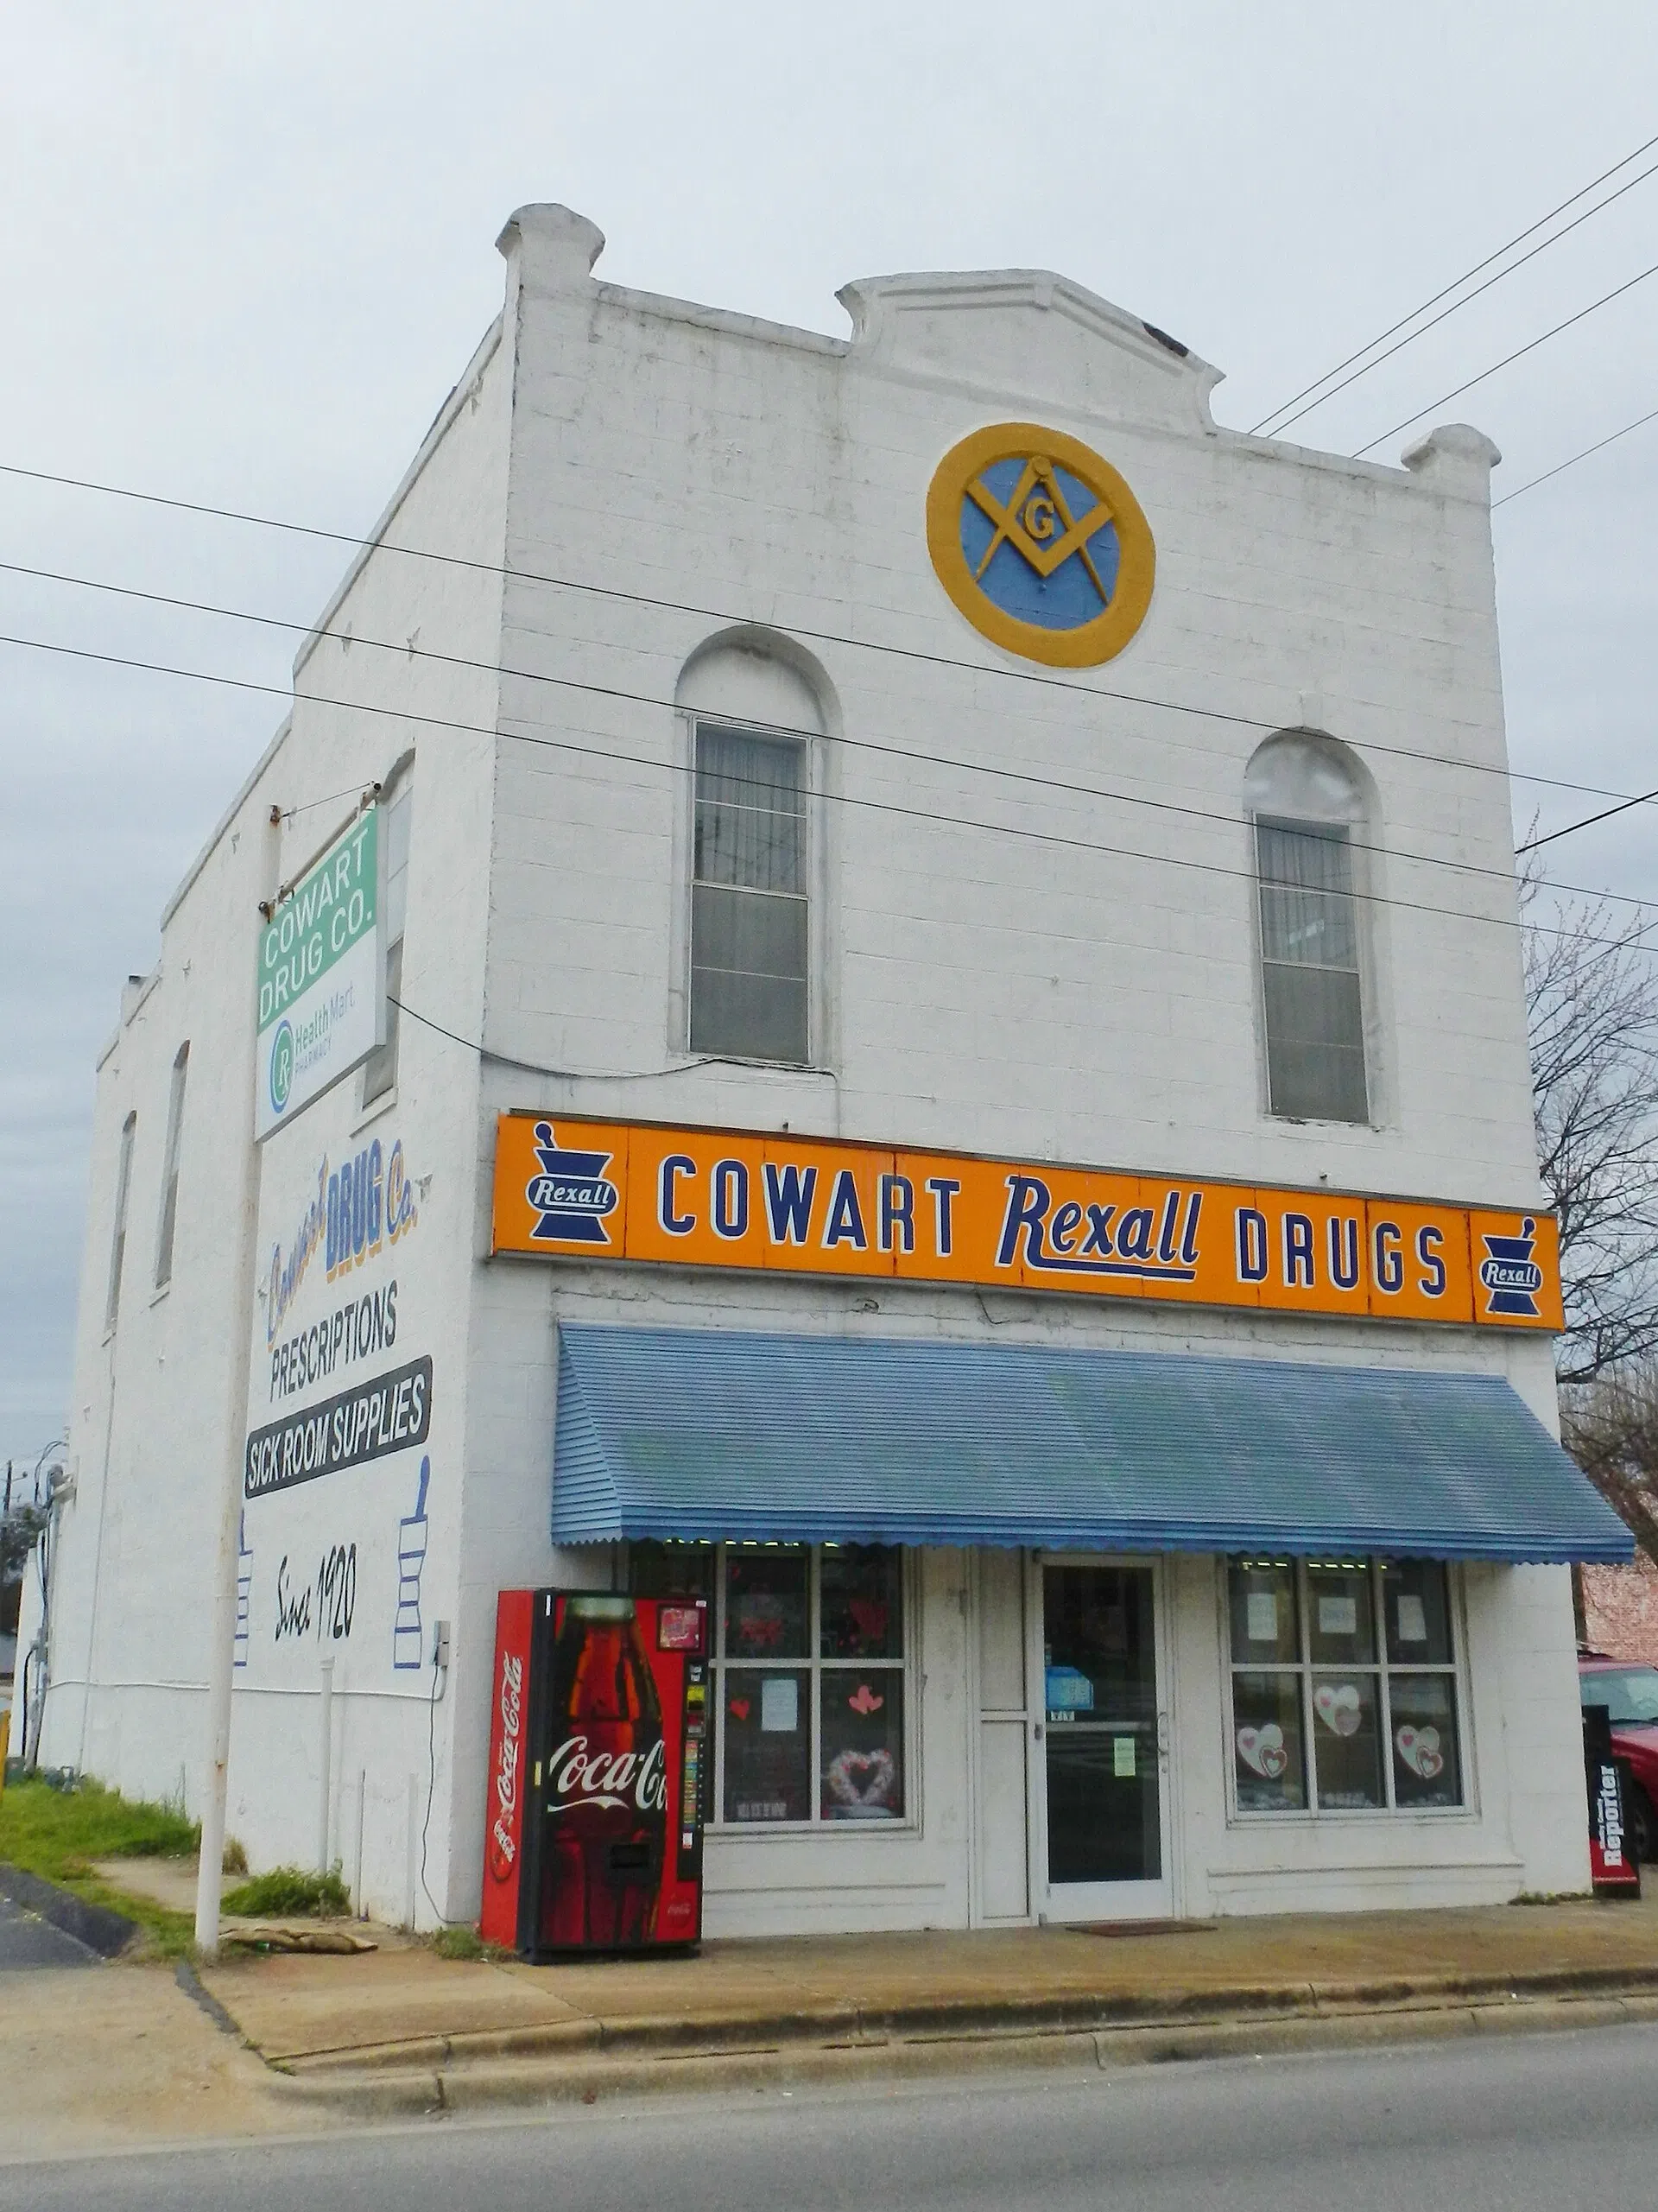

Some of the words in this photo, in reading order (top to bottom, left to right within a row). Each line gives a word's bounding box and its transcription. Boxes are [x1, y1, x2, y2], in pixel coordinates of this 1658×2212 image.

[1025, 497, 1055, 540] G
[265, 827, 369, 968] COWART
[259, 931, 324, 1025] DRUG
[331, 887, 373, 953] CO.
[294, 1003, 329, 1055] Health
[330, 979, 355, 1023] Mart
[326, 1138, 383, 1284] DRUG
[533, 1179, 611, 1209] Rexall
[658, 1153, 961, 1258] COWART
[994, 1174, 1204, 1283] Rexall
[1235, 1206, 1446, 1299] DRUGS
[1485, 1262, 1537, 1288] Rexall
[270, 1280, 397, 1403] PRESCRIPTIONS
[249, 1432, 282, 1490] SICK
[282, 1412, 330, 1479] ROOM
[331, 1373, 426, 1462] SUPPLIES
[275, 1554, 311, 1642] Since
[315, 1542, 357, 1644] 1920
[1600, 1765, 1624, 1867] Reporter
